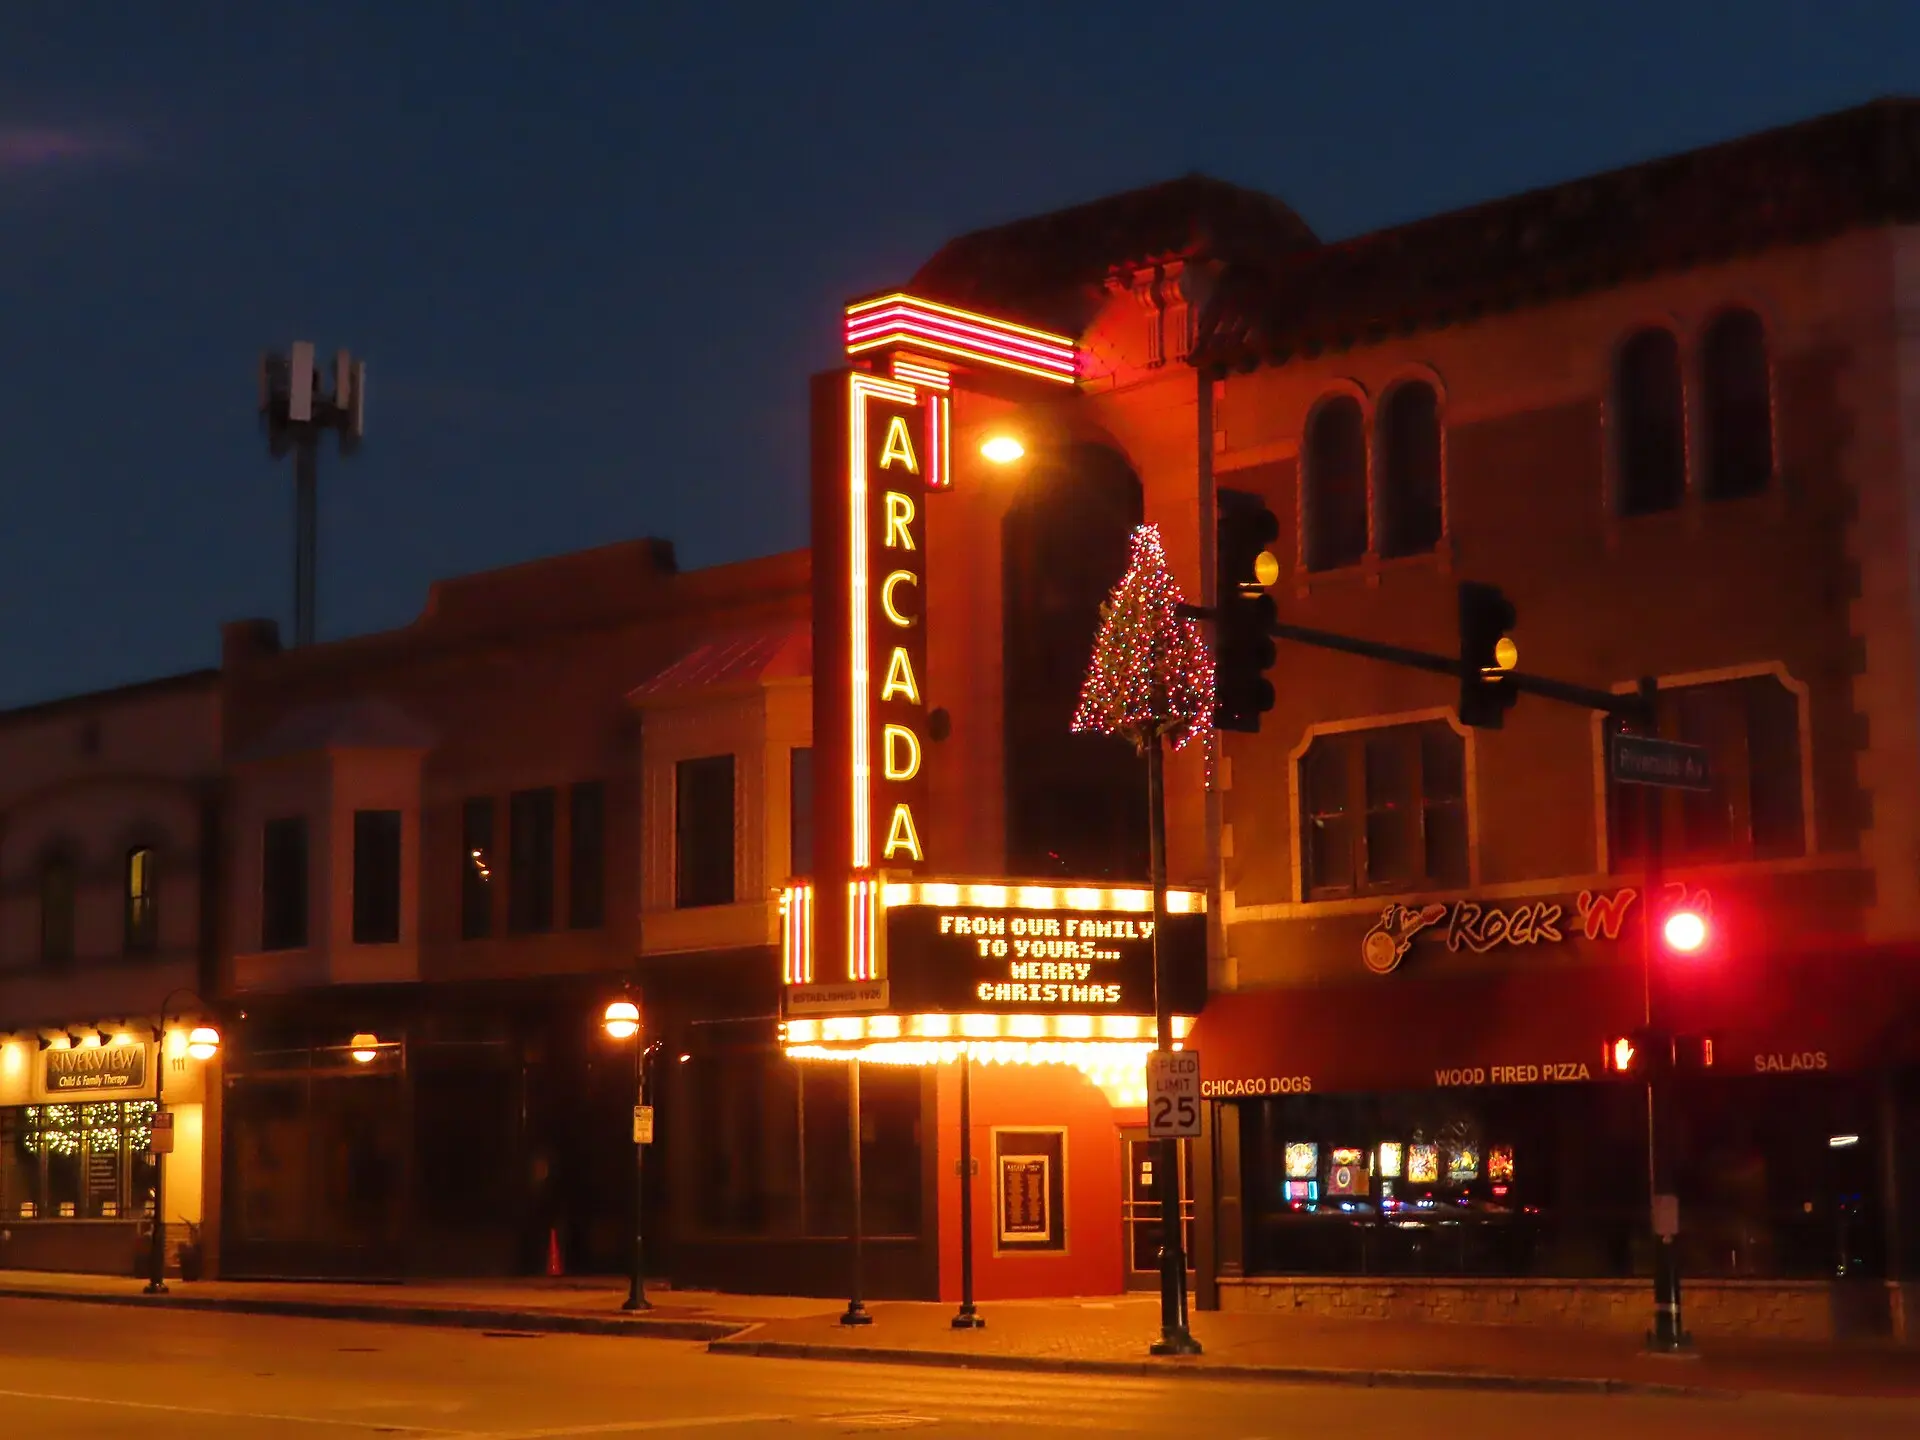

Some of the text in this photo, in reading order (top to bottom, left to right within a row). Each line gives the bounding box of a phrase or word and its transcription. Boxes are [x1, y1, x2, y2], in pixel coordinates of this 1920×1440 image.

[880, 416, 924, 862] ARCADA
[940, 916, 1155, 939] FROM OUR FAMILY
[1447, 901, 1562, 952] ROCK
[977, 939, 1121, 959] TO YOURS...
[1011, 962, 1091, 980] MERRY
[976, 983, 1121, 1002] CHRISTMAS
[50, 1049, 137, 1073] RIVERVIEW
[172, 1057, 185, 1071] 111
[1150, 1059, 1196, 1074] SPEED
[1754, 1051, 1827, 1072] SALADS
[59, 1073, 129, 1087] Child & Family Therapy
[1435, 1063, 1590, 1086] WOOD FIRED PIZZA
[1157, 1079, 1190, 1092] LIMIT
[1201, 1076, 1312, 1096] CHICAGO DOGS
[1154, 1096, 1196, 1128] 25
